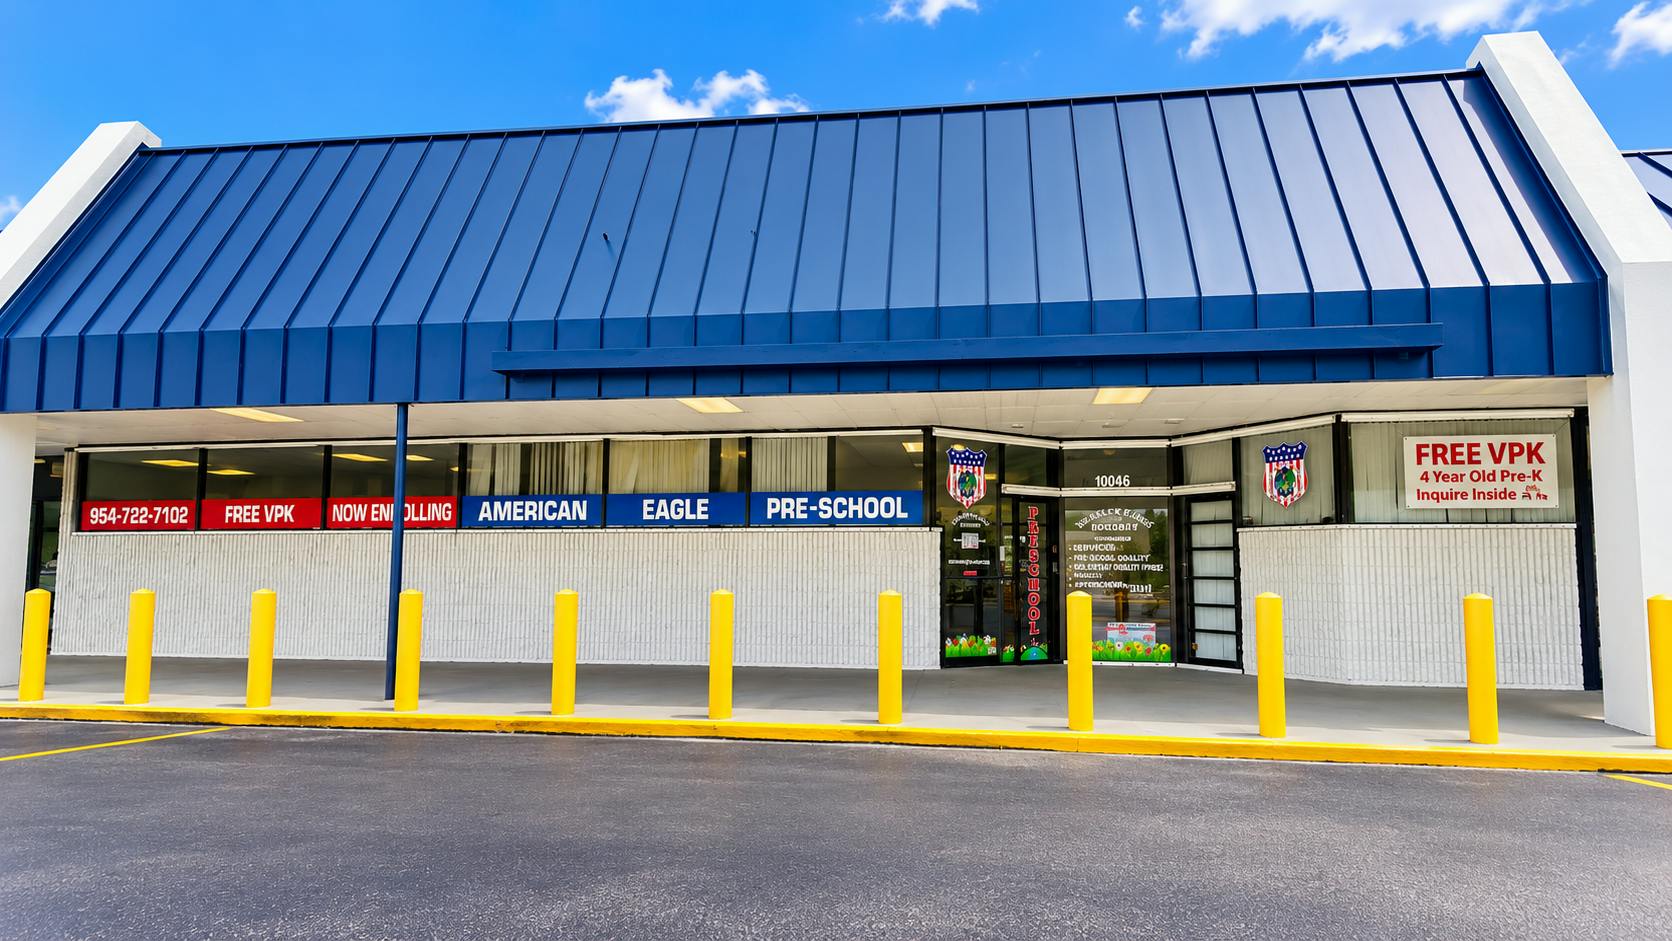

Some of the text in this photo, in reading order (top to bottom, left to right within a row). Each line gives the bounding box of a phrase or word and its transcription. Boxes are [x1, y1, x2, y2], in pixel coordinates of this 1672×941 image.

[1416, 442, 1546, 465] FREE VPK
[1095, 475, 1130, 487] 10046
[1420, 469, 1543, 483] 4 Year Old Pre-K
[1417, 487, 1516, 503] Inquire Inside
[90, 506, 188, 524] 954-722-7102
[225, 504, 294, 523] FREE VPK
[332, 503, 368, 522] NOW
[478, 496, 908, 521] AMERICAN EAGLE PRE-SCHOOL
[1027, 506, 1040, 635] PRESCHOOL
